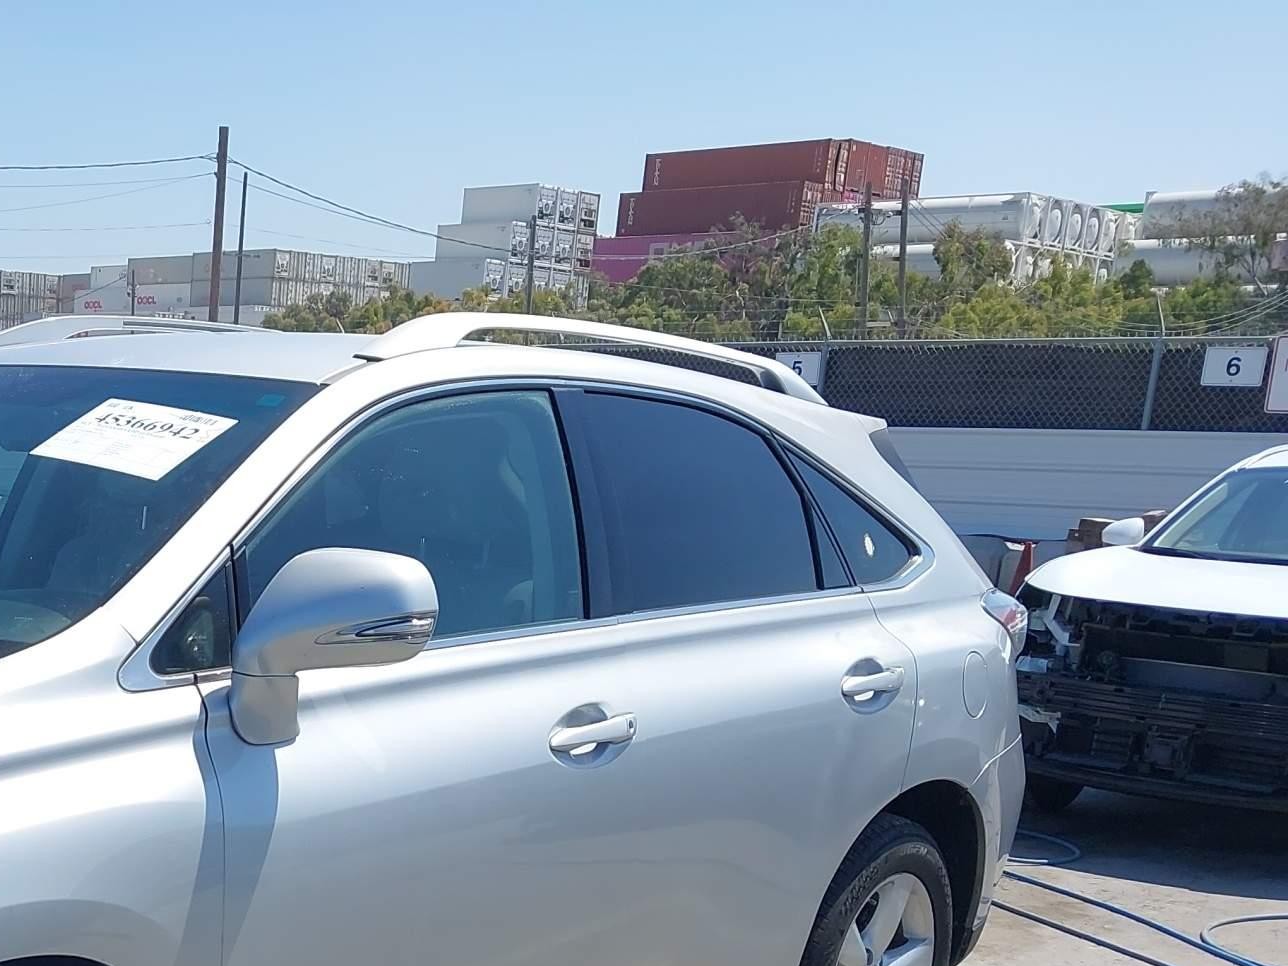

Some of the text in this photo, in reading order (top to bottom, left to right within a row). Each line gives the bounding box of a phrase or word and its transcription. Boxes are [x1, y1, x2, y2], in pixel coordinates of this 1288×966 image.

[84, 300, 103, 309] OOCL
[136, 295, 157, 304] OOCL
[792, 360, 803, 376] 5
[1225, 356, 1242, 377] 6
[95, 412, 201, 440] 45366942
